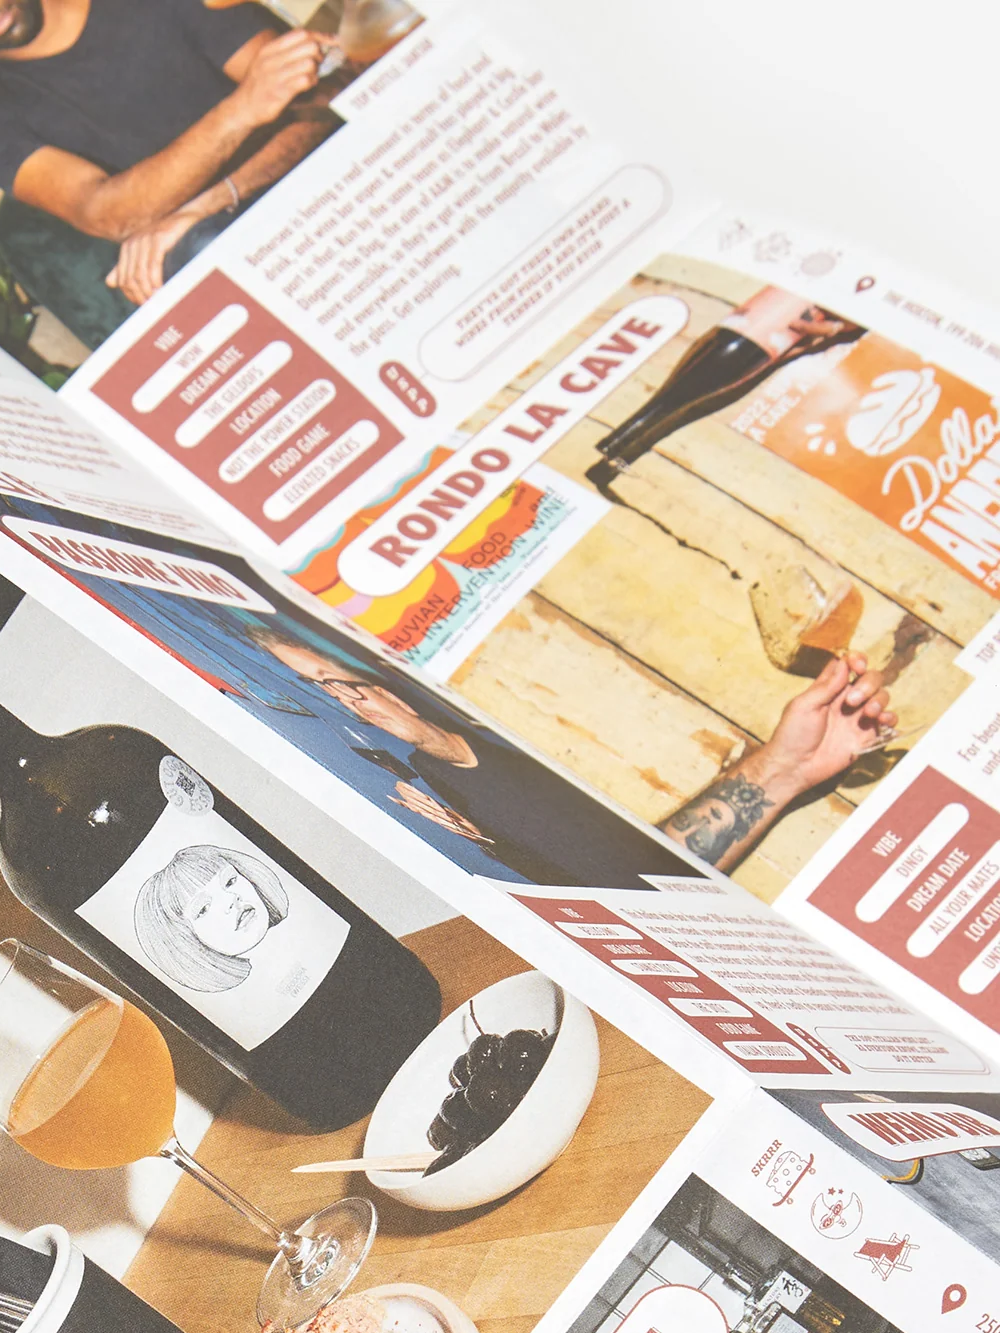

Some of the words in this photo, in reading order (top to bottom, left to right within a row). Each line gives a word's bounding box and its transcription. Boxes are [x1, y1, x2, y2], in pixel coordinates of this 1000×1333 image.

[369, 447, 512, 568] RONDO
[505, 395, 560, 444] LA
[559, 316, 661, 394] CAVE
[28, 531, 180, 586] PASSIONE
[160, 561, 247, 601] VINO
[421, 533, 527, 640] INTERVENTION
[525, 492, 569, 532] WINE
[462, 530, 507, 573] FOOD
[871, 829, 902, 857] VIBE
[894, 844, 928, 878] DINGY
[905, 871, 948, 912] DREAM
[936, 846, 970, 878] DATE
[928, 915, 951, 936] ALL
[942, 888, 974, 917] YOUR
[966, 859, 1000, 893] MATES
[847, 1111, 961, 1146] WEINO
[751, 1139, 783, 1177] SKRRR
